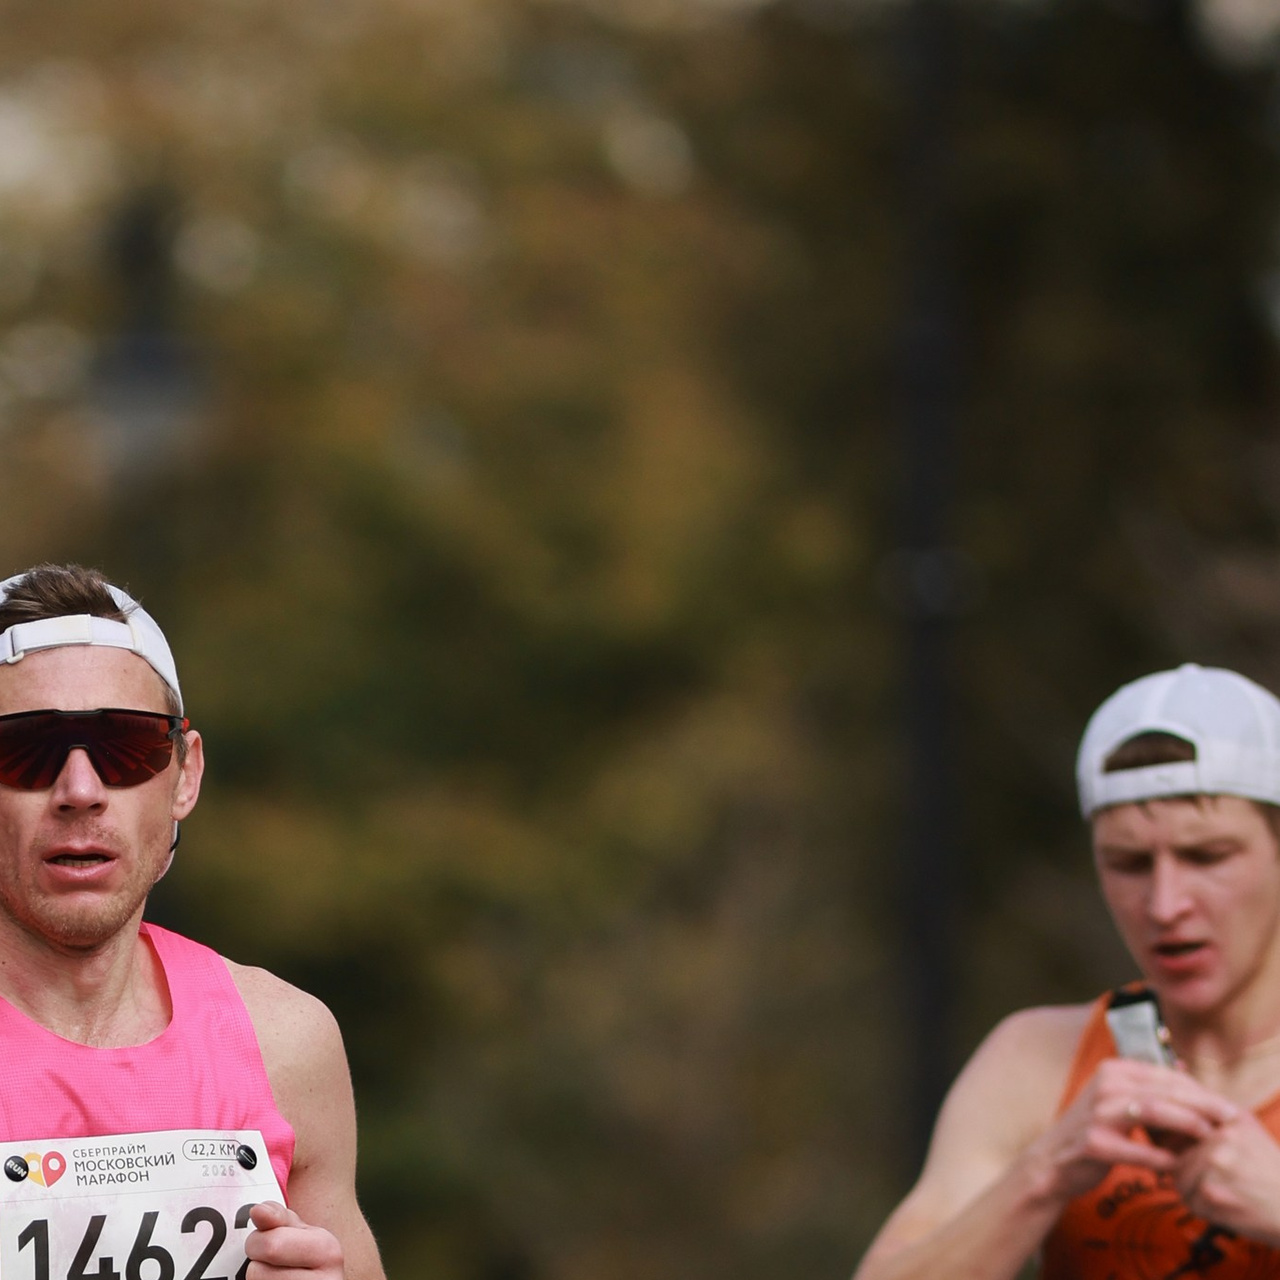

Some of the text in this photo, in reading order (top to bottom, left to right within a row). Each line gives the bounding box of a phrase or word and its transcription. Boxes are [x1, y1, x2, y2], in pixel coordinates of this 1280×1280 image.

[72, 1144, 147, 1159] СБЕРПРАЙМ
[191, 1143, 216, 1157] 42,2
[6, 1160, 27, 1178] RUN
[74, 1152, 176, 1173] МОСКОВСКИЙ
[76, 1171, 150, 1187] МАРАФОН
